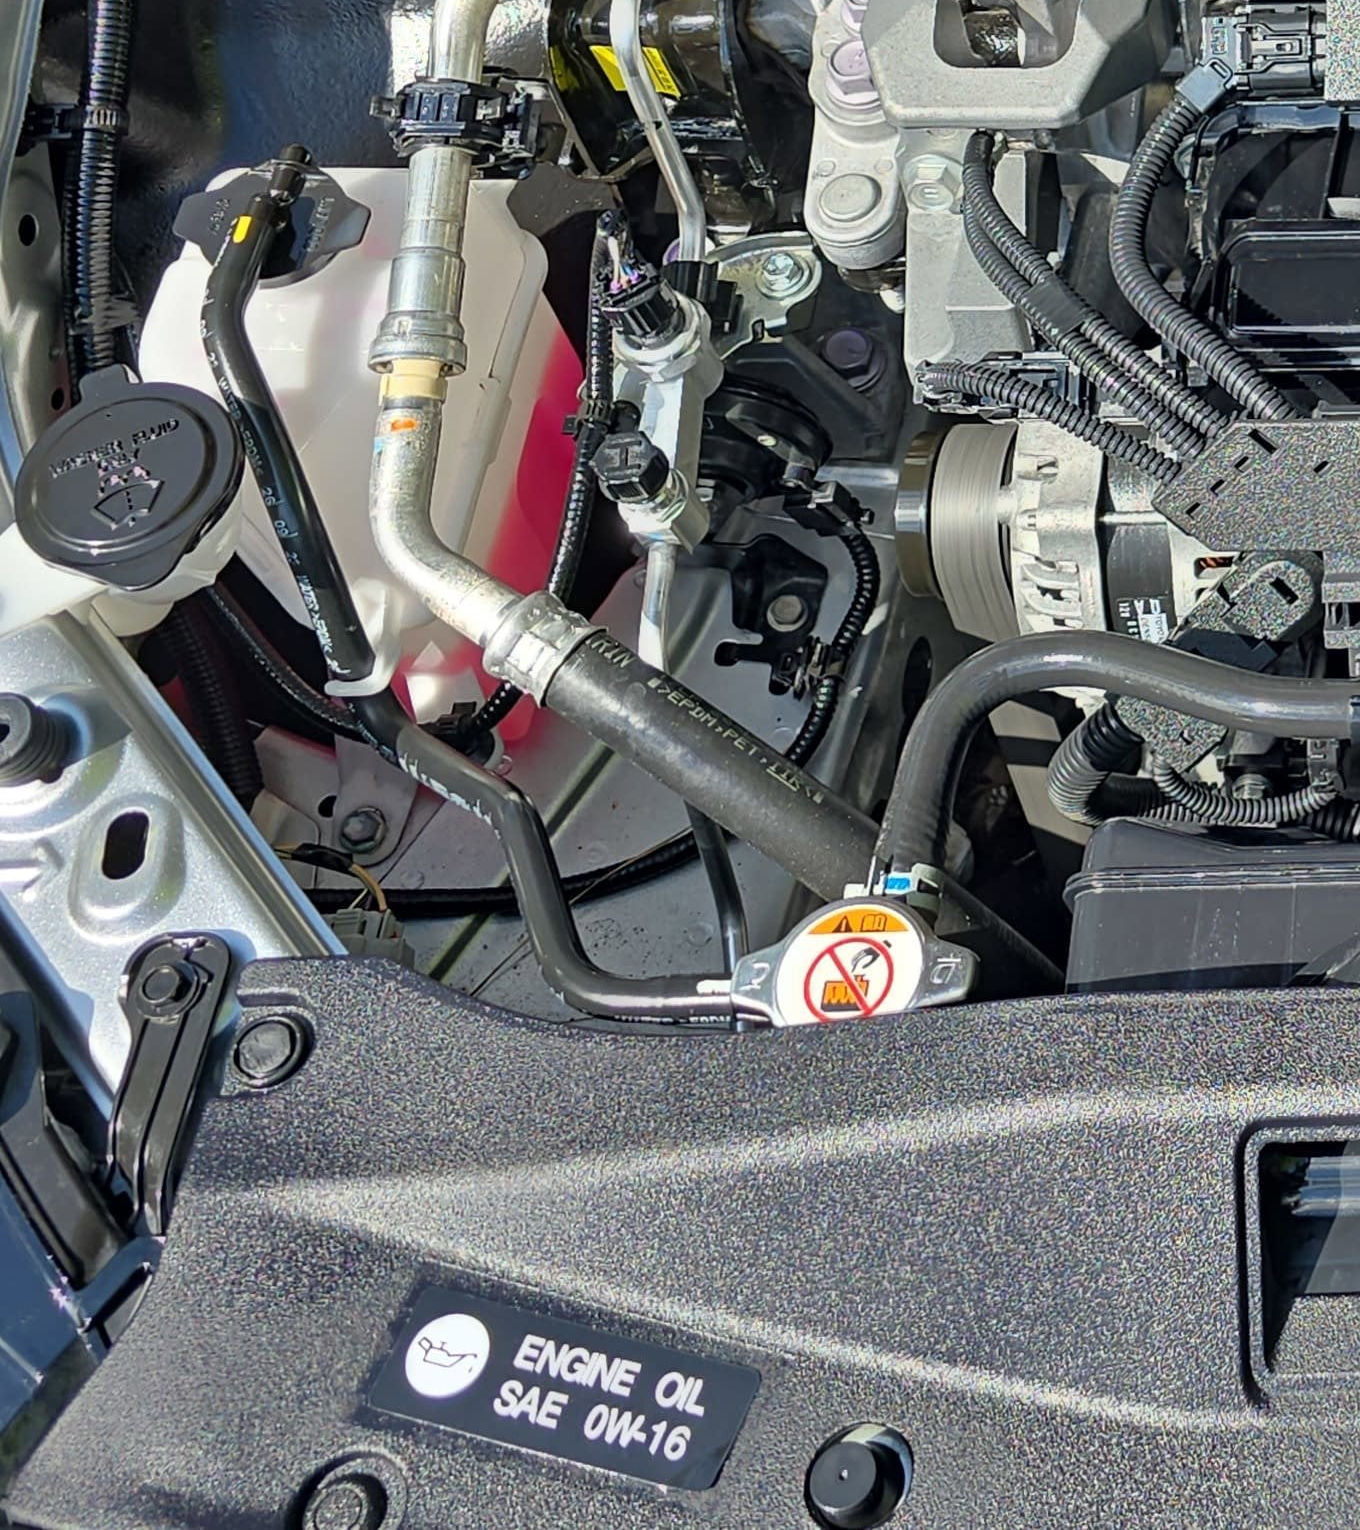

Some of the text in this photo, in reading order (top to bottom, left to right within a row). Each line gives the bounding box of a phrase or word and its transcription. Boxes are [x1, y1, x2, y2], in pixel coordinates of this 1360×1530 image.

[49, 418, 181, 478] WASHER FLUID
[513, 1333, 706, 1418] ENGINE OIL
[493, 1379, 693, 1463] SAE 0W-16
